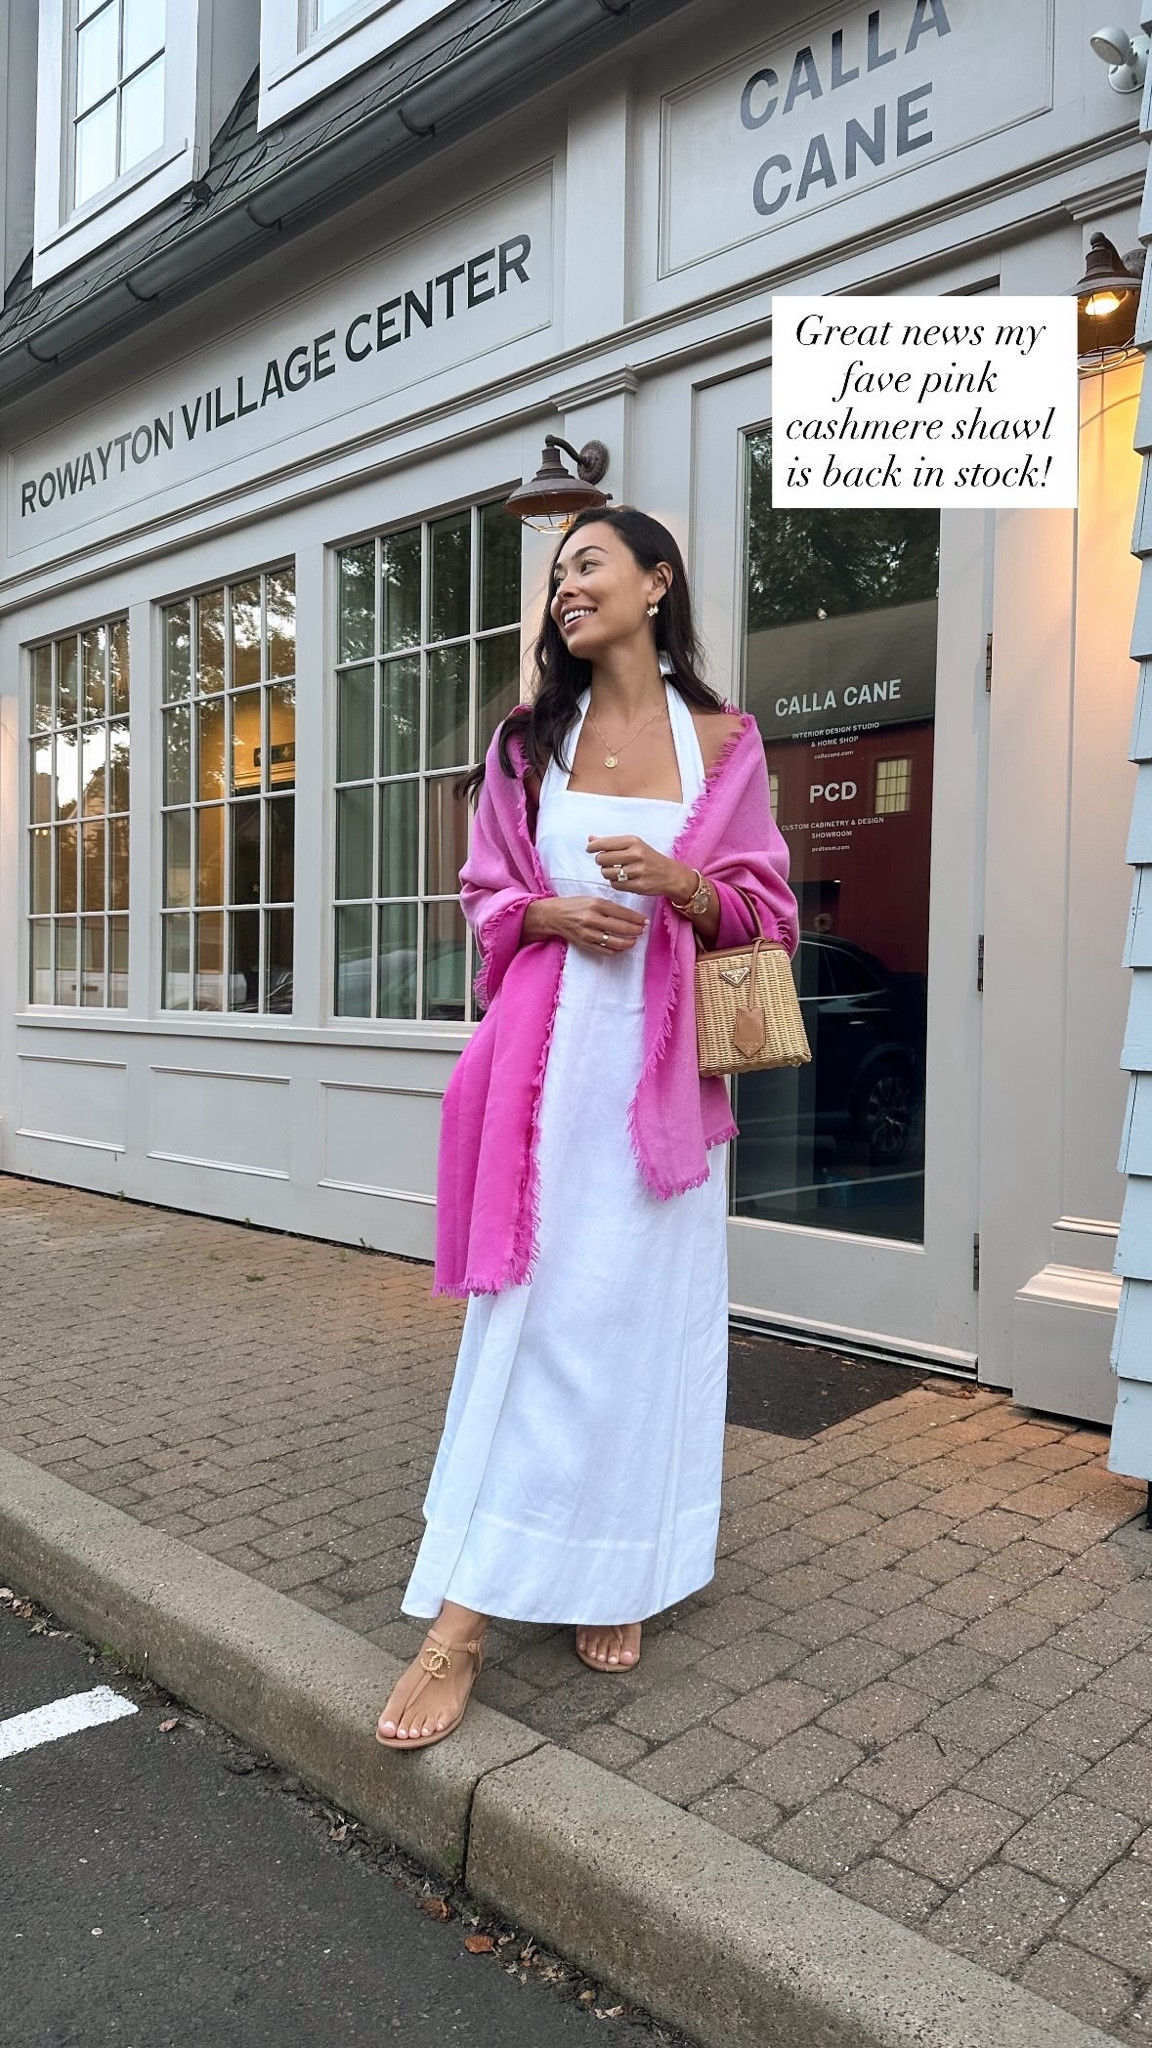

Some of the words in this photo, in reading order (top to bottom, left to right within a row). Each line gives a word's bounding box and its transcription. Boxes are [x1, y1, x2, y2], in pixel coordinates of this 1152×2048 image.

[740, 0, 952, 130] CALLA
[752, 81, 933, 216] CANE
[21, 411, 175, 518] ROWAYTON
[180, 329, 337, 441] VILLAGE
[345, 233, 532, 363] CENTER
[775, 690, 837, 717] CALLA
[843, 678, 902, 707] CANE
[792, 729, 825, 739] INTERIOR
[825, 725, 852, 736] DESIGN
[852, 721, 880, 732] STUDIO
[817, 738, 838, 748] HOME
[838, 735, 859, 745] SHOP
[813, 750, 854, 760] callacane.com
[809, 781, 858, 804] PCD
[781, 823, 809, 832] CUSTOM
[810, 819, 849, 830] CABINETRY
[857, 817, 884, 826] DESIGN
[811, 830, 853, 839] SHOWROOM
[811, 844, 850, 853] pcdteam.com
